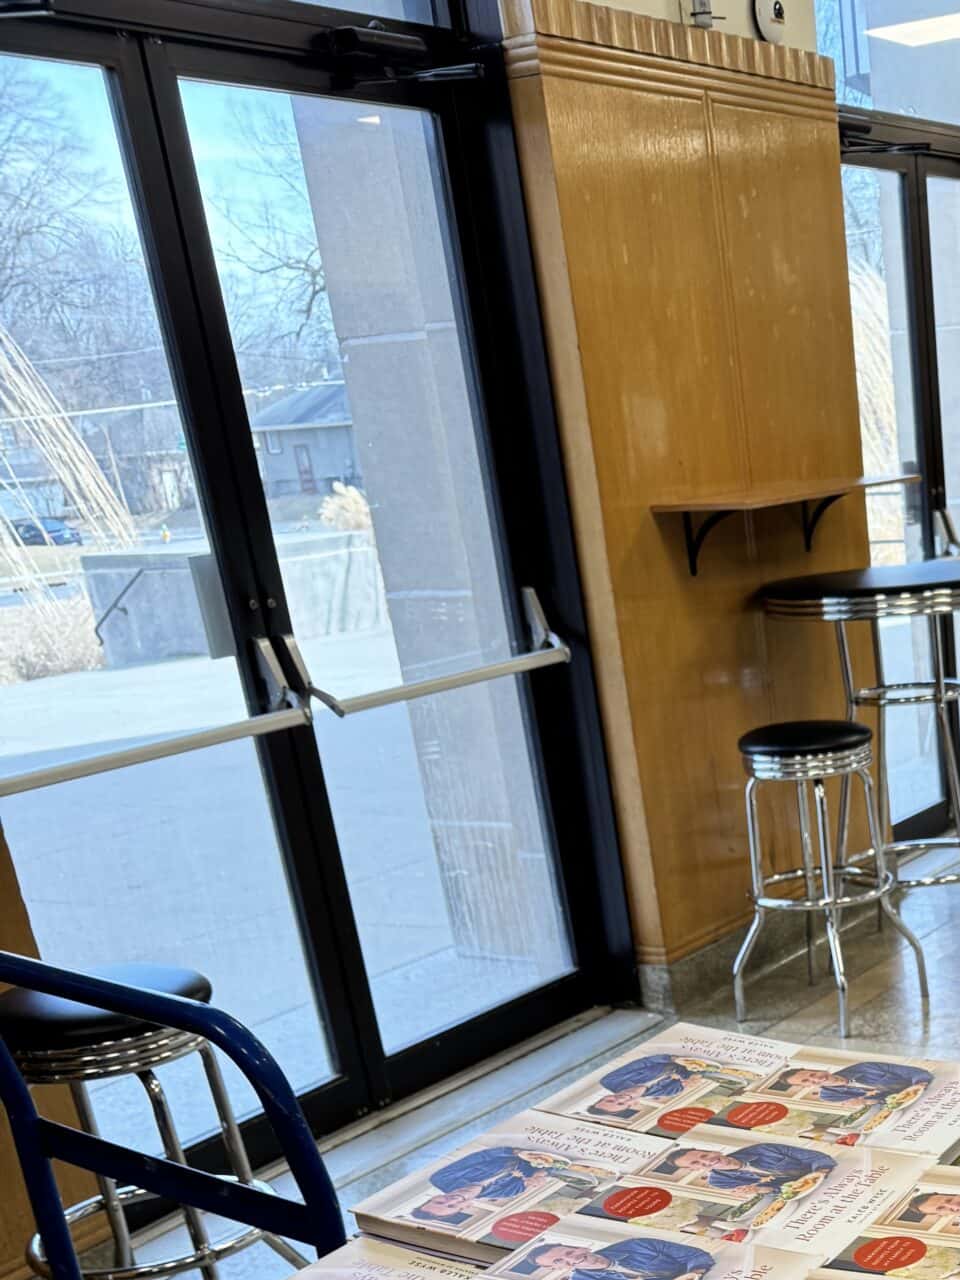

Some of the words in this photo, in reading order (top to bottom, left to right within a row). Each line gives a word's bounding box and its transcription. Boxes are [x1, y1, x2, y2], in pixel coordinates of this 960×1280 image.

[783, 1199, 830, 1230] There's
[824, 1168, 864, 1200] Always
[795, 1215, 835, 1242] Room
[830, 1206, 848, 1215] at
[840, 1188, 864, 1204] the
[857, 1165, 890, 1190] Table
